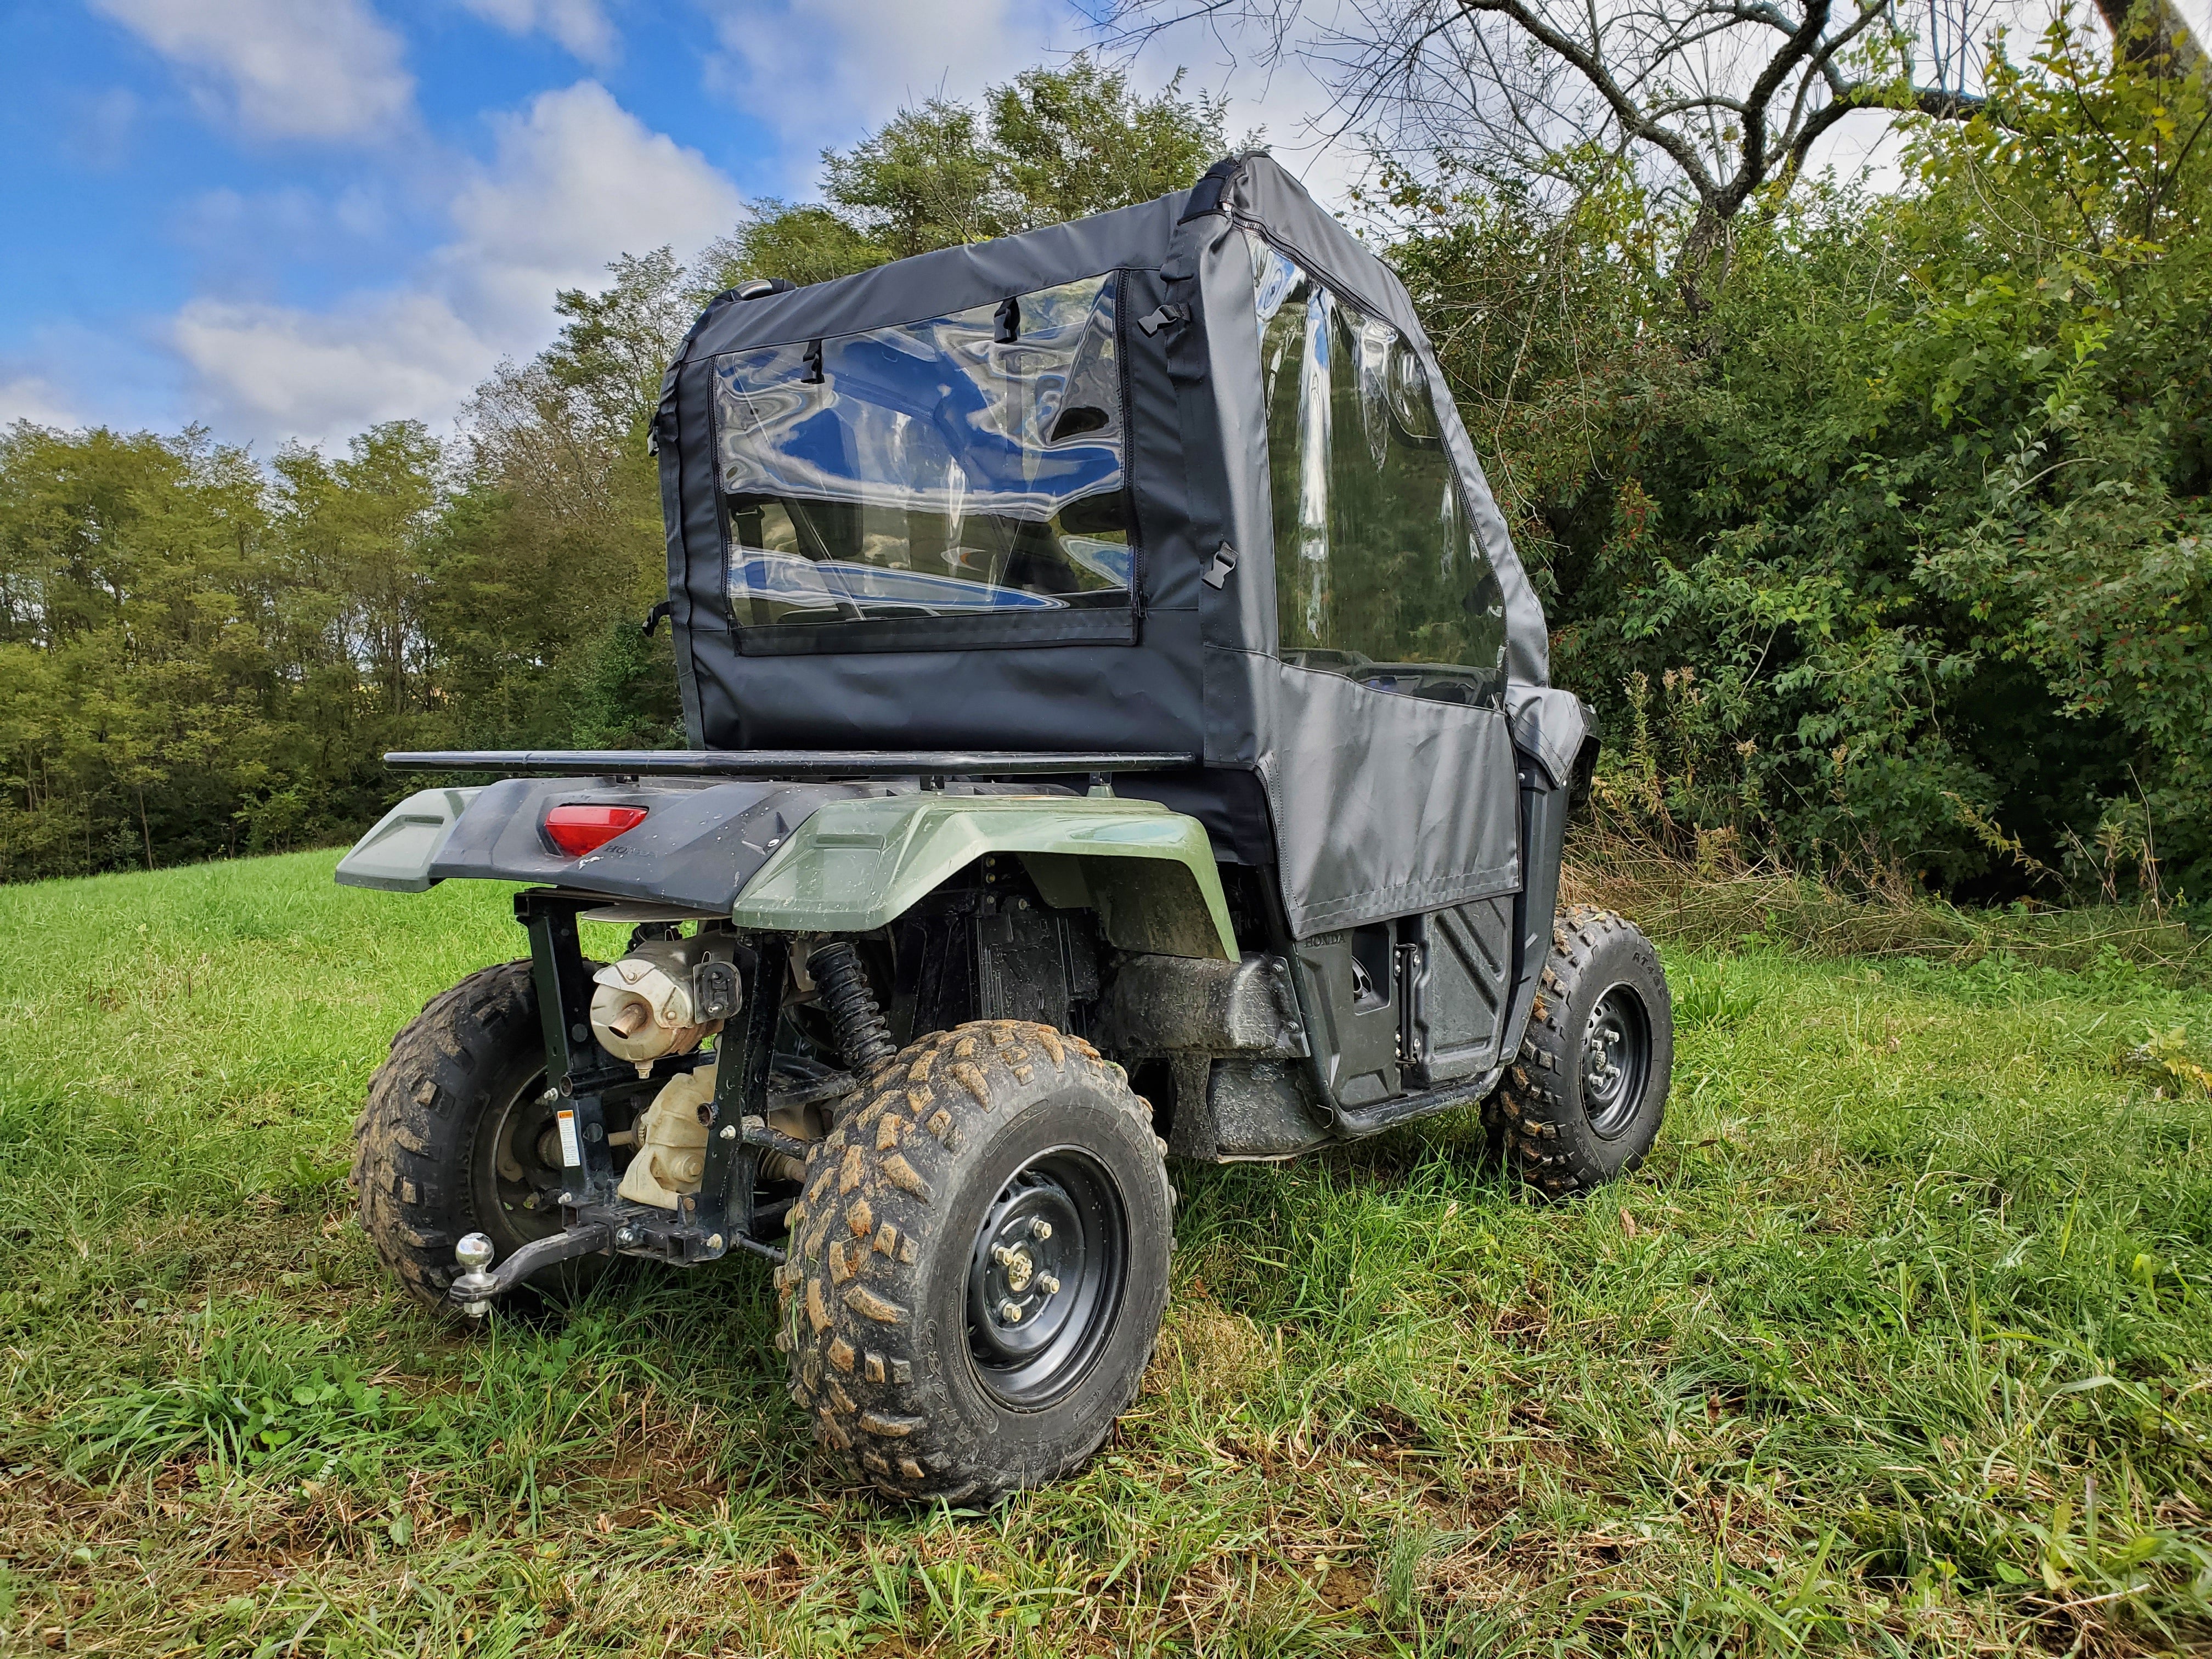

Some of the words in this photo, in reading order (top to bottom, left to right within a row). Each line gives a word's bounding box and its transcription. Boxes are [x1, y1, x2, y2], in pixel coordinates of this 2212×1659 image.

[603, 845, 658, 858] HONDA
[1304, 934, 1345, 947] HONDA
[926, 1318, 976, 1445] AT489
